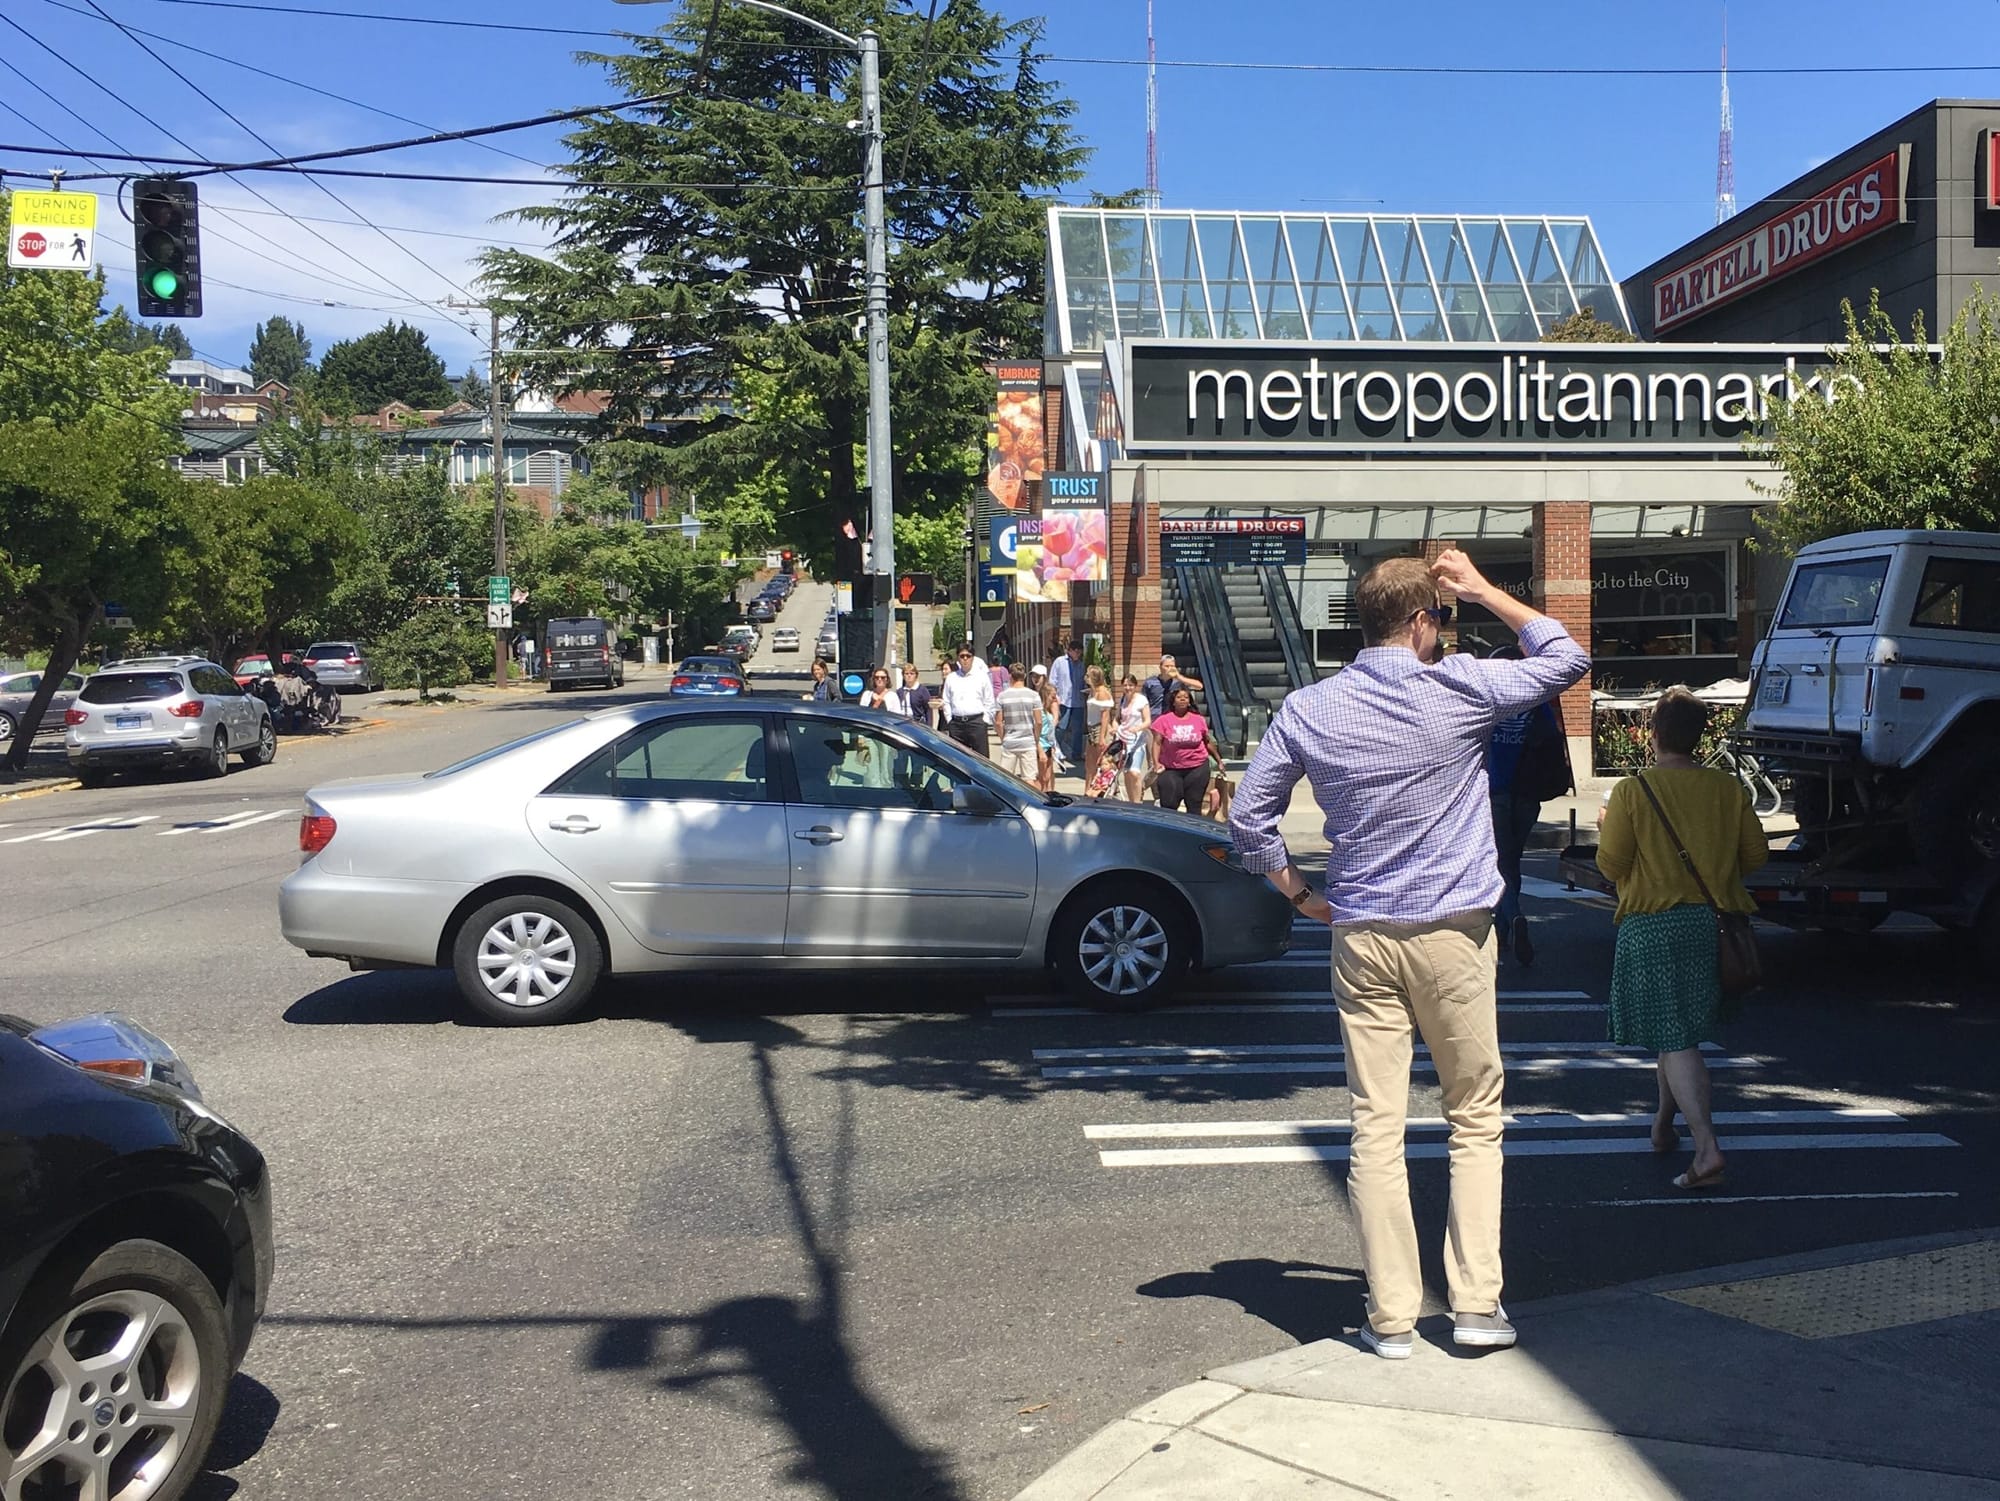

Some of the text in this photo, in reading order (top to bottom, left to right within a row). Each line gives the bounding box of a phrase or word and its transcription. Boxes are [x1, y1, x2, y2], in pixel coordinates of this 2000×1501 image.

[24, 197, 88, 210] TURNING
[24, 213, 86, 225] VEHICLES
[18, 239, 65, 251] STOP FOR
[1659, 169, 1881, 322] BARTELL DRUGS
[998, 367, 1041, 379] EMBRACE
[1188, 355, 1865, 438] metropolitanmarke
[1049, 477, 1099, 496] TRUST
[1161, 520, 1300, 533] BARTELL DRUGS
[1610, 575, 1626, 589] to
[1628, 571, 1653, 588] the
[1654, 568, 1690, 590] City
